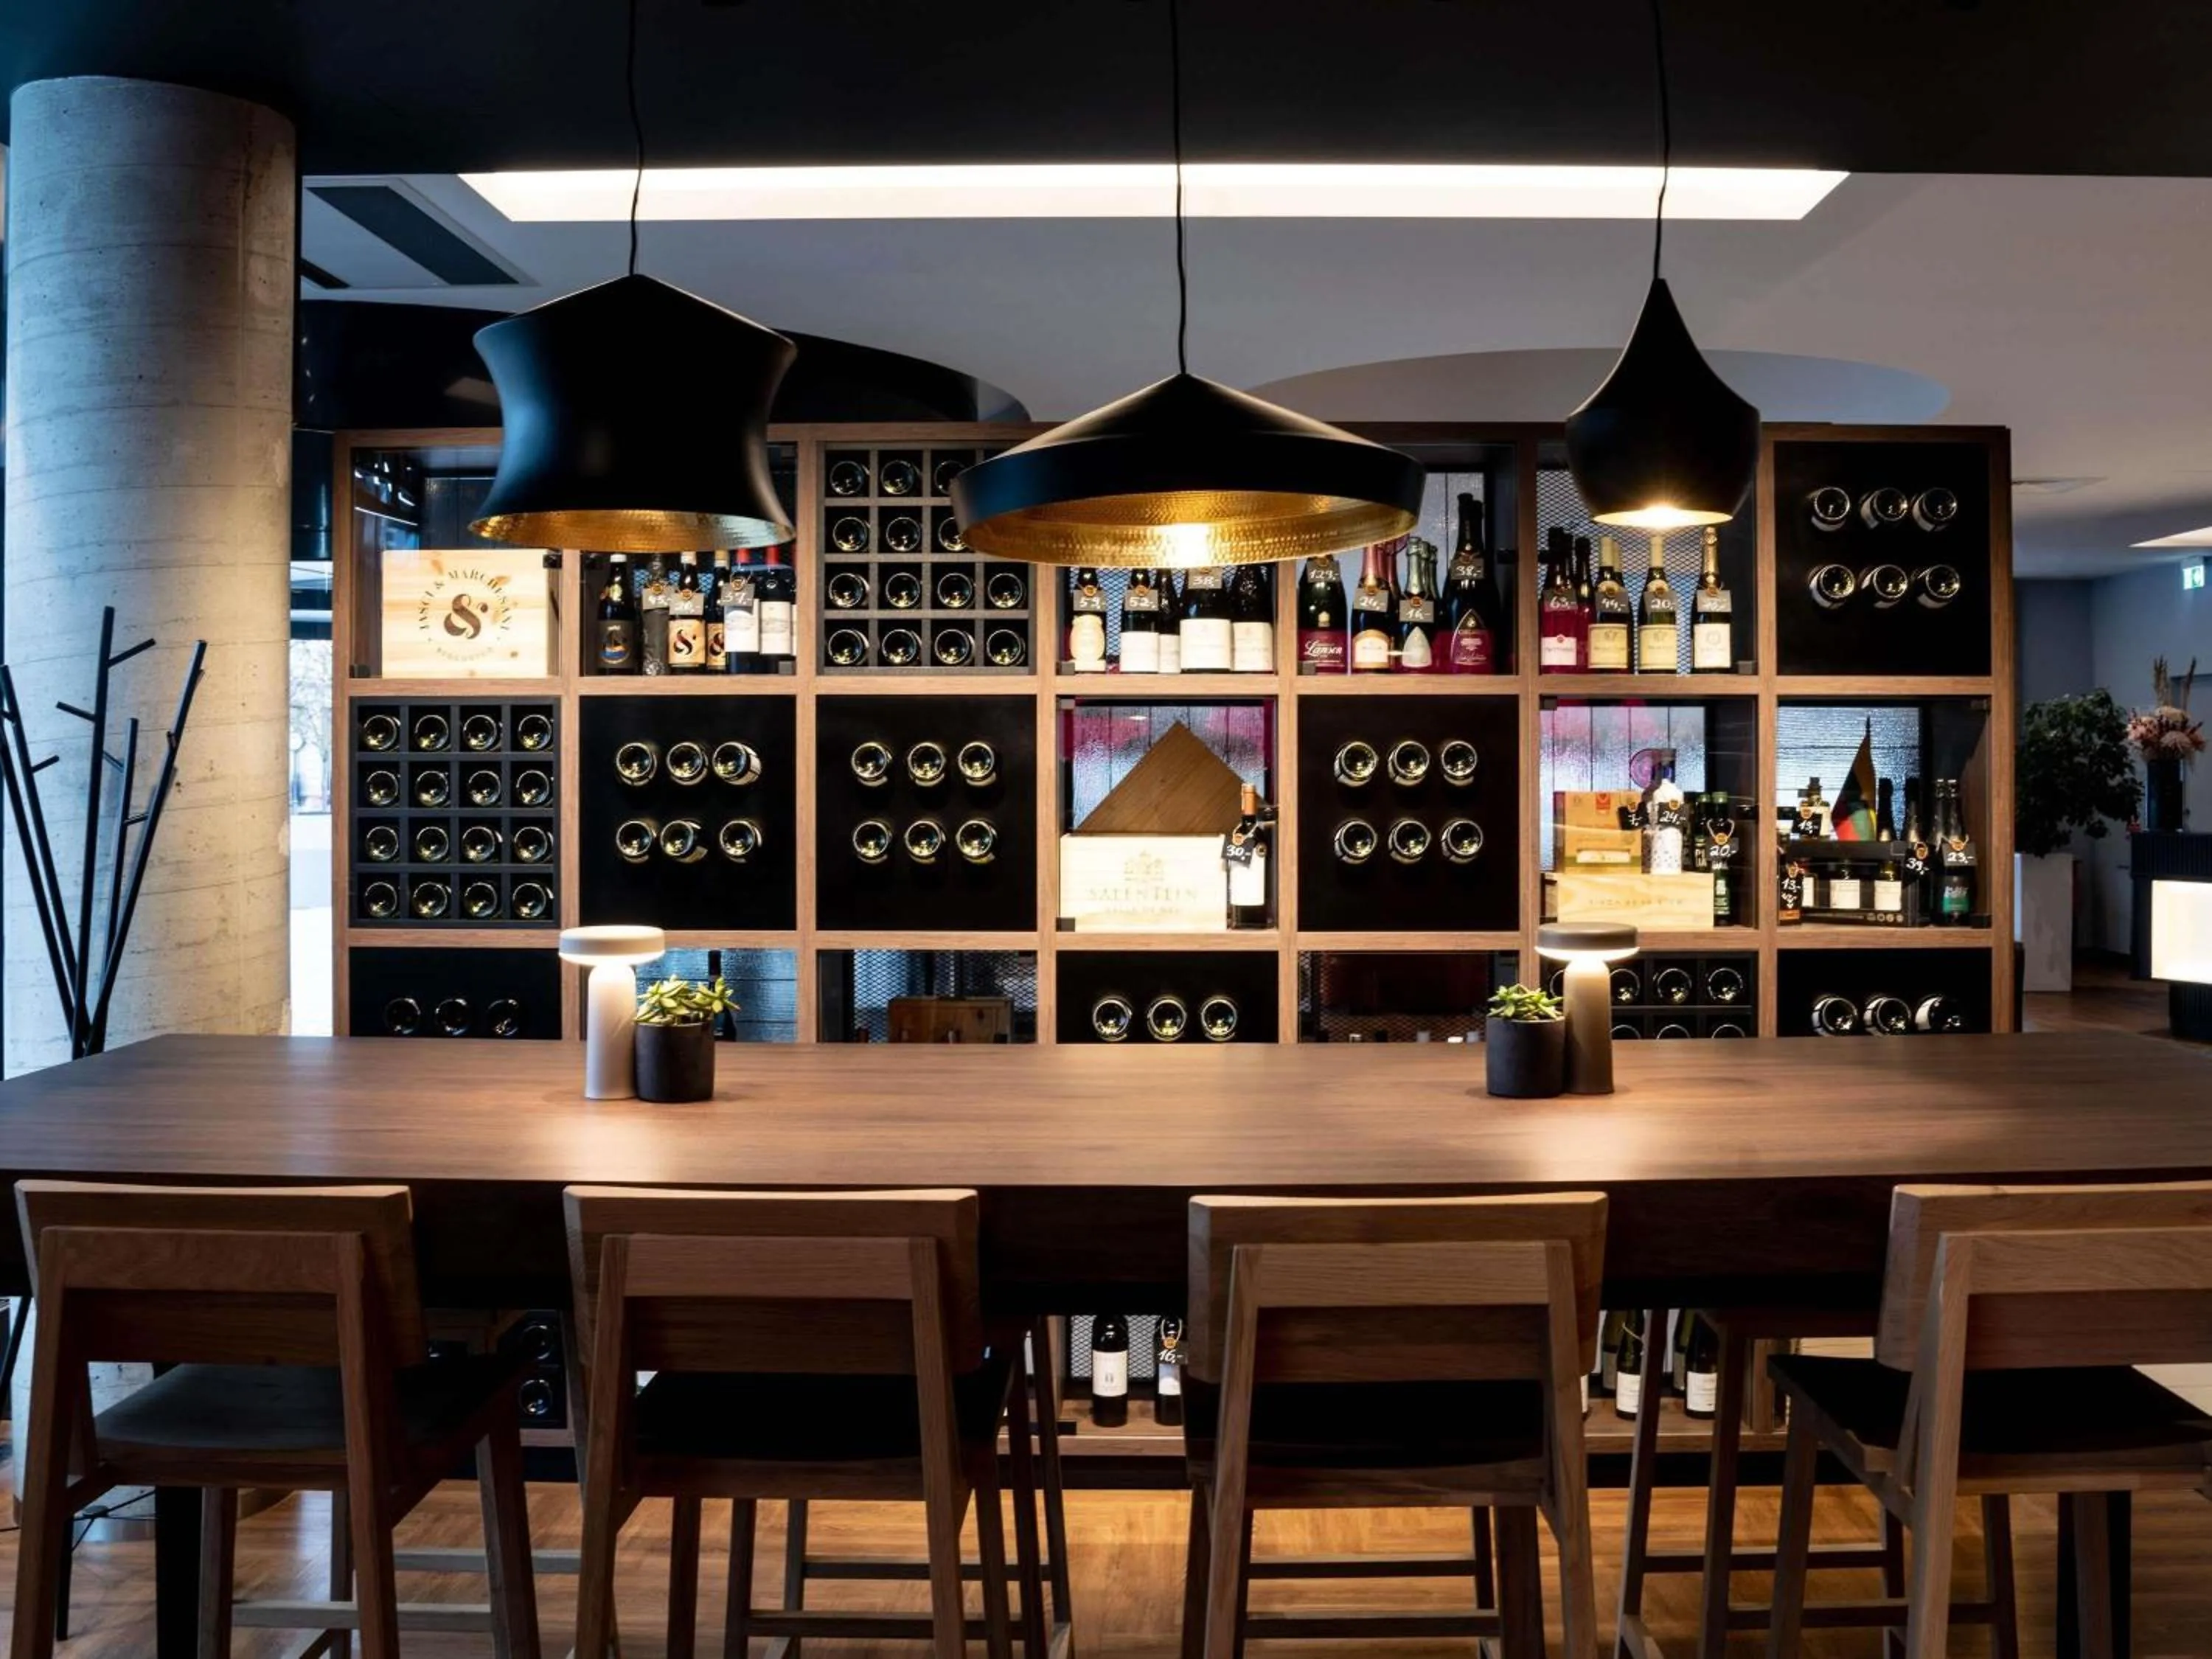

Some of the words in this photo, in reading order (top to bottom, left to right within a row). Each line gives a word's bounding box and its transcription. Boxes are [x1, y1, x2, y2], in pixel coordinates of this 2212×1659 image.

[1304, 639, 1343, 658] Lanson
[1710, 844, 1737, 858] 20,-
[1157, 1349, 1183, 1364] 16,-
